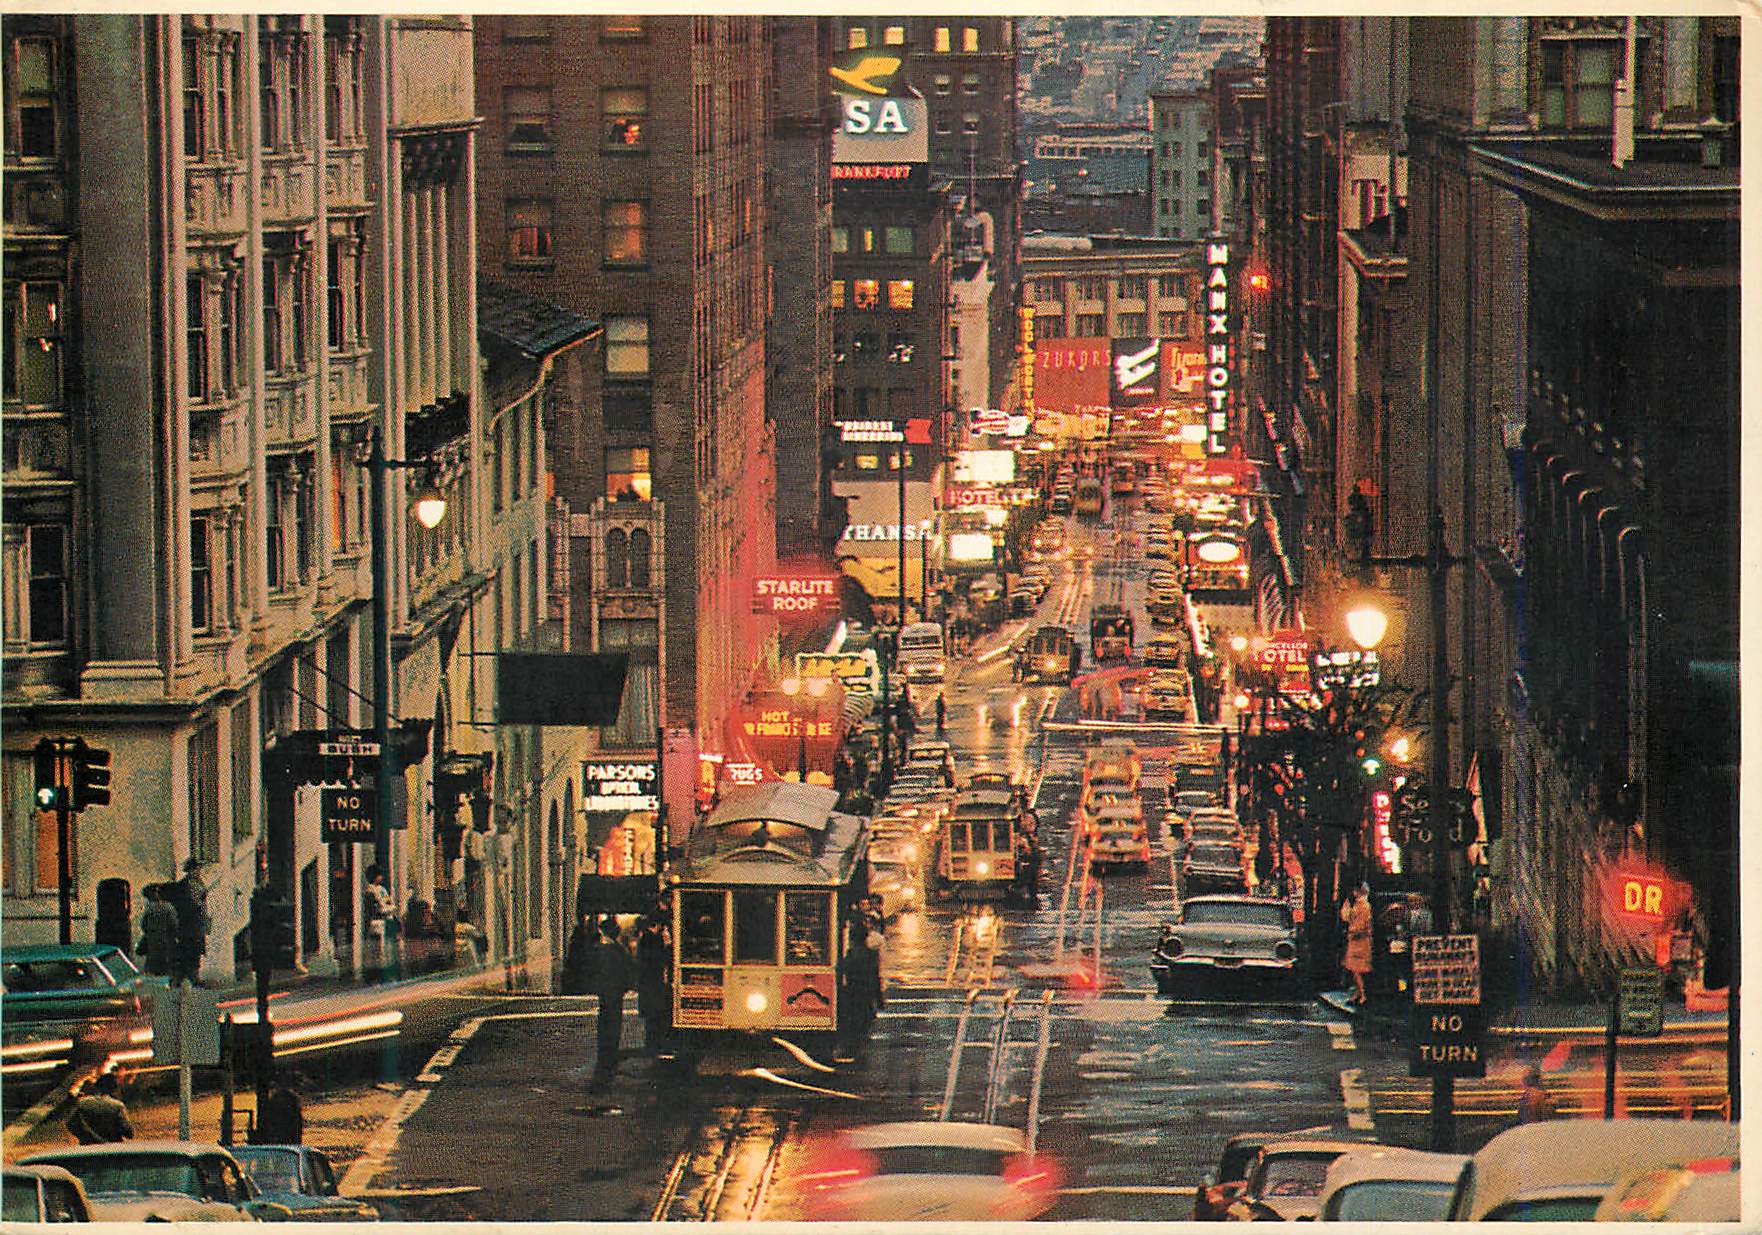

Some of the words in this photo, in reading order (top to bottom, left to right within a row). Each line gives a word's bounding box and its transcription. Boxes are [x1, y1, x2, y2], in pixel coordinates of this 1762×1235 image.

[1207, 244, 1228, 334] MANX
[1208, 345, 1228, 453] HOTEL
[757, 579, 834, 595] STARLITE
[773, 597, 818, 610] ROOF
[762, 711, 790, 722] HOT
[587, 765, 655, 780] PARSONS
[338, 796, 360, 809] NO
[329, 819, 371, 831] TURN
[1624, 881, 1663, 914] DR
[1432, 1015, 1462, 1031] NO
[1420, 1045, 1478, 1062] TURN
